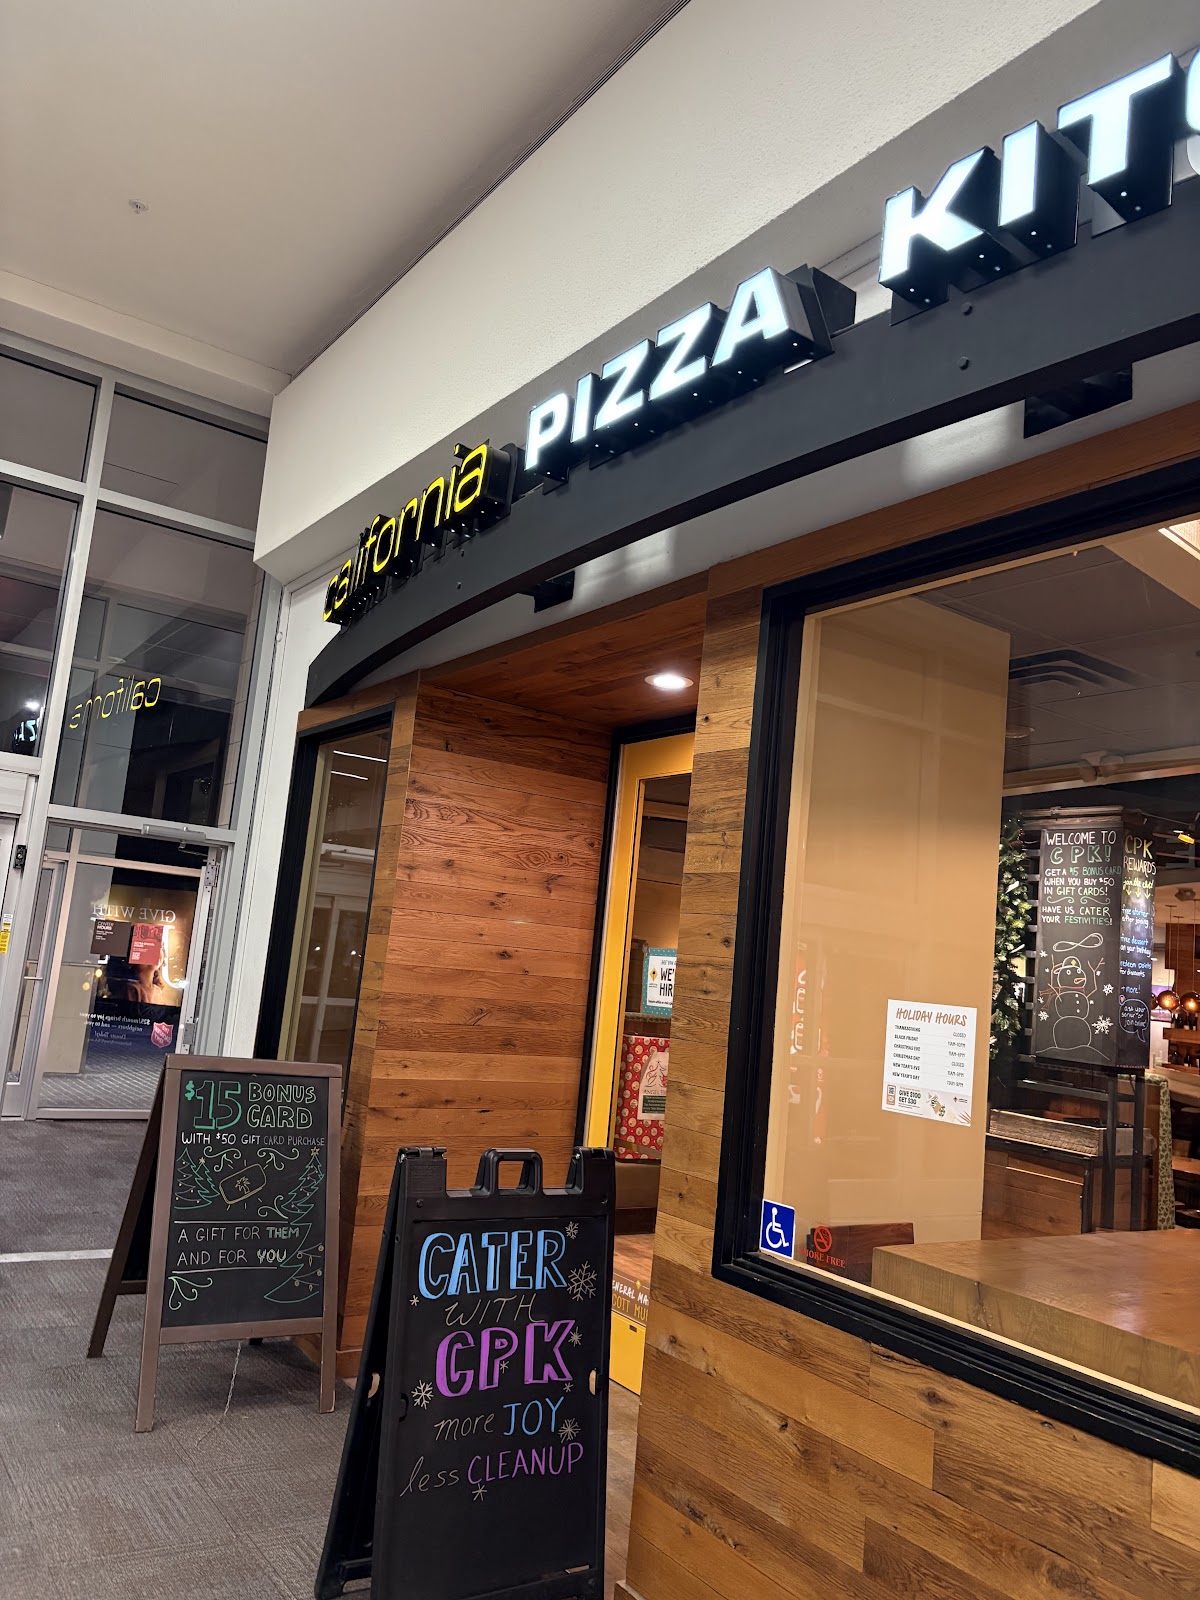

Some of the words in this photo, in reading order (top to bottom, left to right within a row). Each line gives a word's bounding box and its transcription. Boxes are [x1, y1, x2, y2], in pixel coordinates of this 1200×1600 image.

[322, 442, 488, 622] california
[525, 266, 791, 471] PIZZA
[878, 46, 1200, 286] KIT
[1046, 831, 1096, 845] WELCOME
[1101, 830, 1117, 845] TO
[1124, 834, 1153, 860] CPK
[1045, 868, 1061, 877] GET
[1062, 868, 1067, 876] A
[1082, 866, 1104, 876] BONUS
[1104, 865, 1122, 875] CARD
[1123, 855, 1157, 878] REWARDS
[1043, 886, 1053, 896] IN
[1056, 886, 1076, 896] GIFT
[1077, 886, 1108, 897] CARDS!
[1044, 877, 1065, 886] WHEN
[1067, 877, 1081, 886] YOU
[1083, 878, 1097, 886] BUY
[1099, 877, 1115, 887] $50
[1041, 915, 1061, 924] YOUR
[1064, 915, 1113, 926] FESTIVITIES!
[1042, 905, 1062, 914] HAVE
[1064, 906, 1075, 915] US
[1079, 906, 1111, 918] CATER
[660, 967, 675, 982] WE'
[659, 983, 673, 997] HIR
[895, 1007, 933, 1023] HOLIDAY
[935, 1012, 968, 1027] HOURS
[184, 1080, 243, 1130] $15
[248, 1082, 317, 1104] BONUS
[246, 1104, 313, 1129] CARD
[181, 1131, 211, 1145] WITH
[216, 1132, 237, 1145] $50
[241, 1133, 261, 1145] GIFT
[263, 1135, 285, 1146] CARD
[287, 1135, 326, 1147] PURCHASE
[177, 1227, 189, 1244] A
[195, 1226, 226, 1242] GIFT
[234, 1225, 261, 1240] FOR
[266, 1226, 300, 1240] THEM
[177, 1250, 211, 1266] AND
[218, 1248, 248, 1264] FOR
[257, 1248, 288, 1264] YOU
[418, 1230, 567, 1300] CATER
[826, 1255, 846, 1269] FREE
[612, 1280, 636, 1299] ENERAL
[637, 1292, 649, 1306] MA
[612, 1293, 631, 1313] COTT
[444, 1293, 546, 1326] WITH
[435, 1319, 575, 1398] CPK
[434, 1412, 495, 1441] more
[503, 1396, 565, 1436] JOY
[400, 1455, 460, 1497] less
[467, 1442, 584, 1485] CLEANUP
